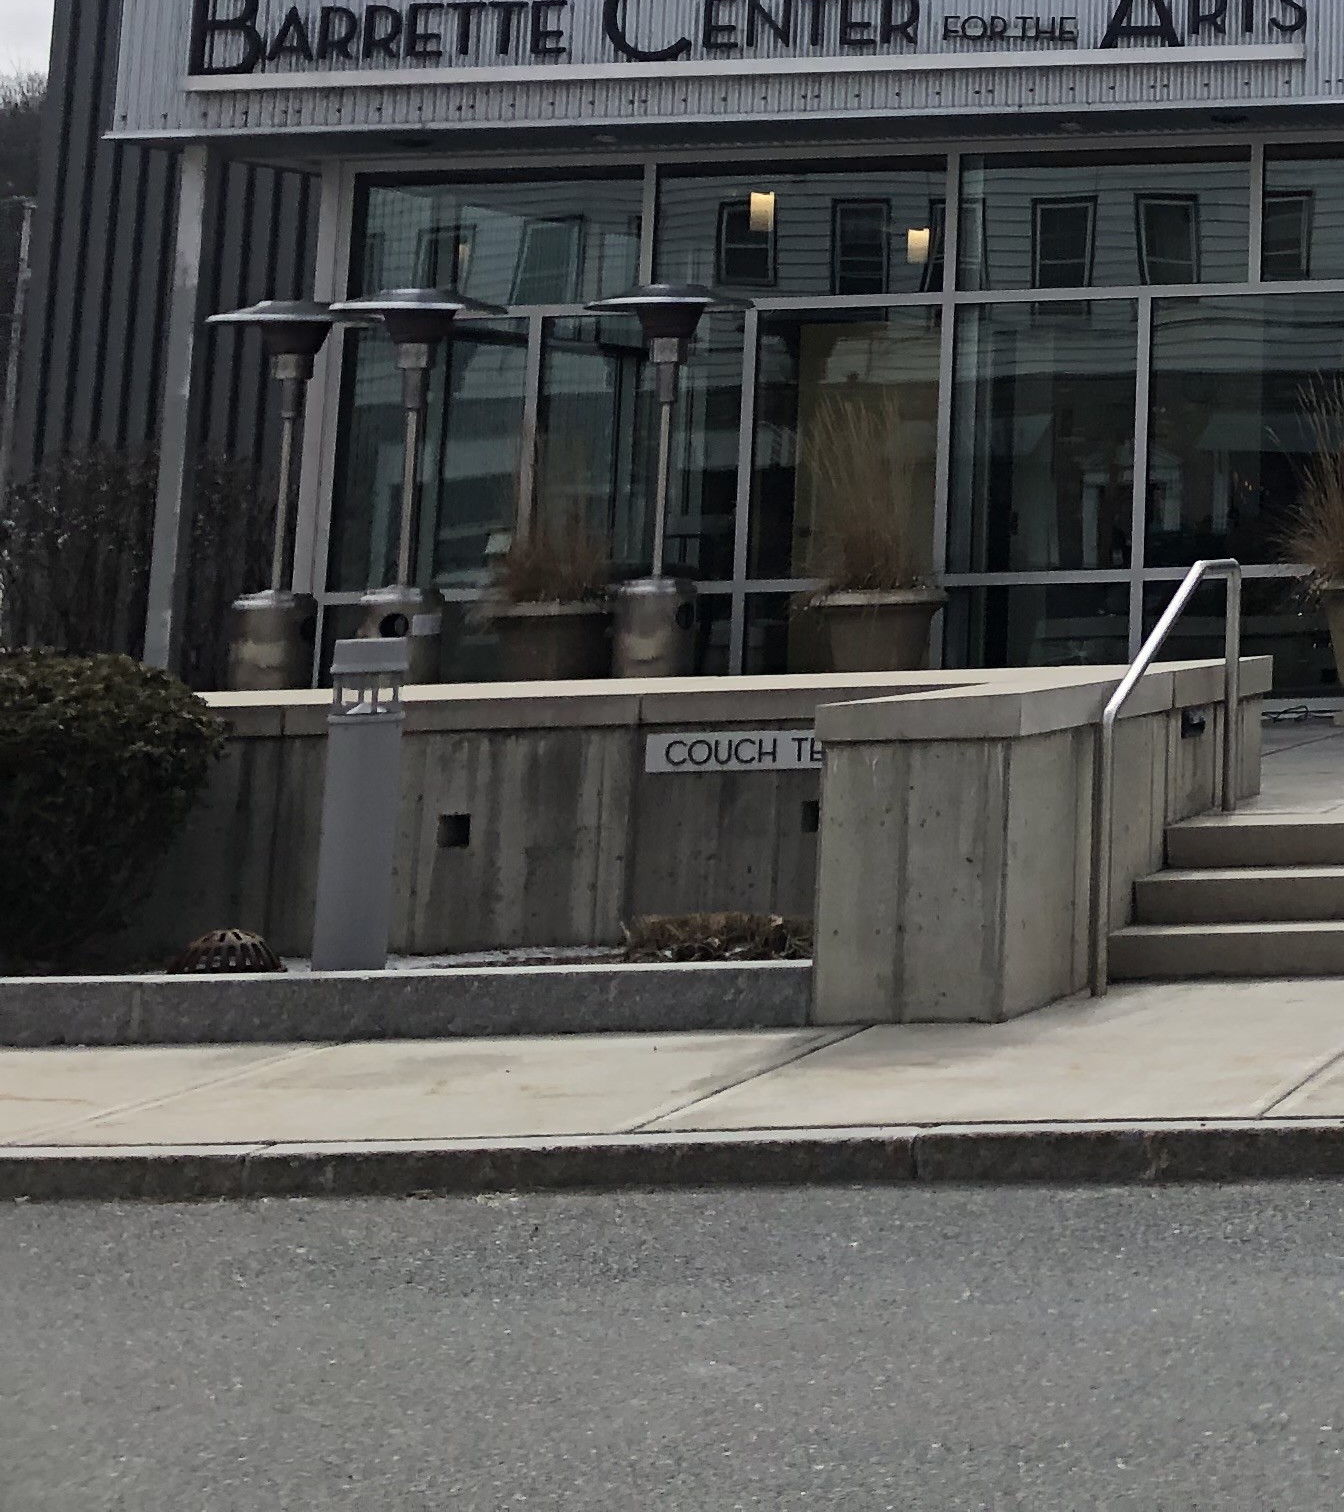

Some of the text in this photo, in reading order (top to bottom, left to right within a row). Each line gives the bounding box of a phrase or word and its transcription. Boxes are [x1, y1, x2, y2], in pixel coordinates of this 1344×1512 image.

[943, 15, 1007, 42] FOR
[1014, 14, 1077, 42] THE
[664, 738, 777, 767] COUCH
